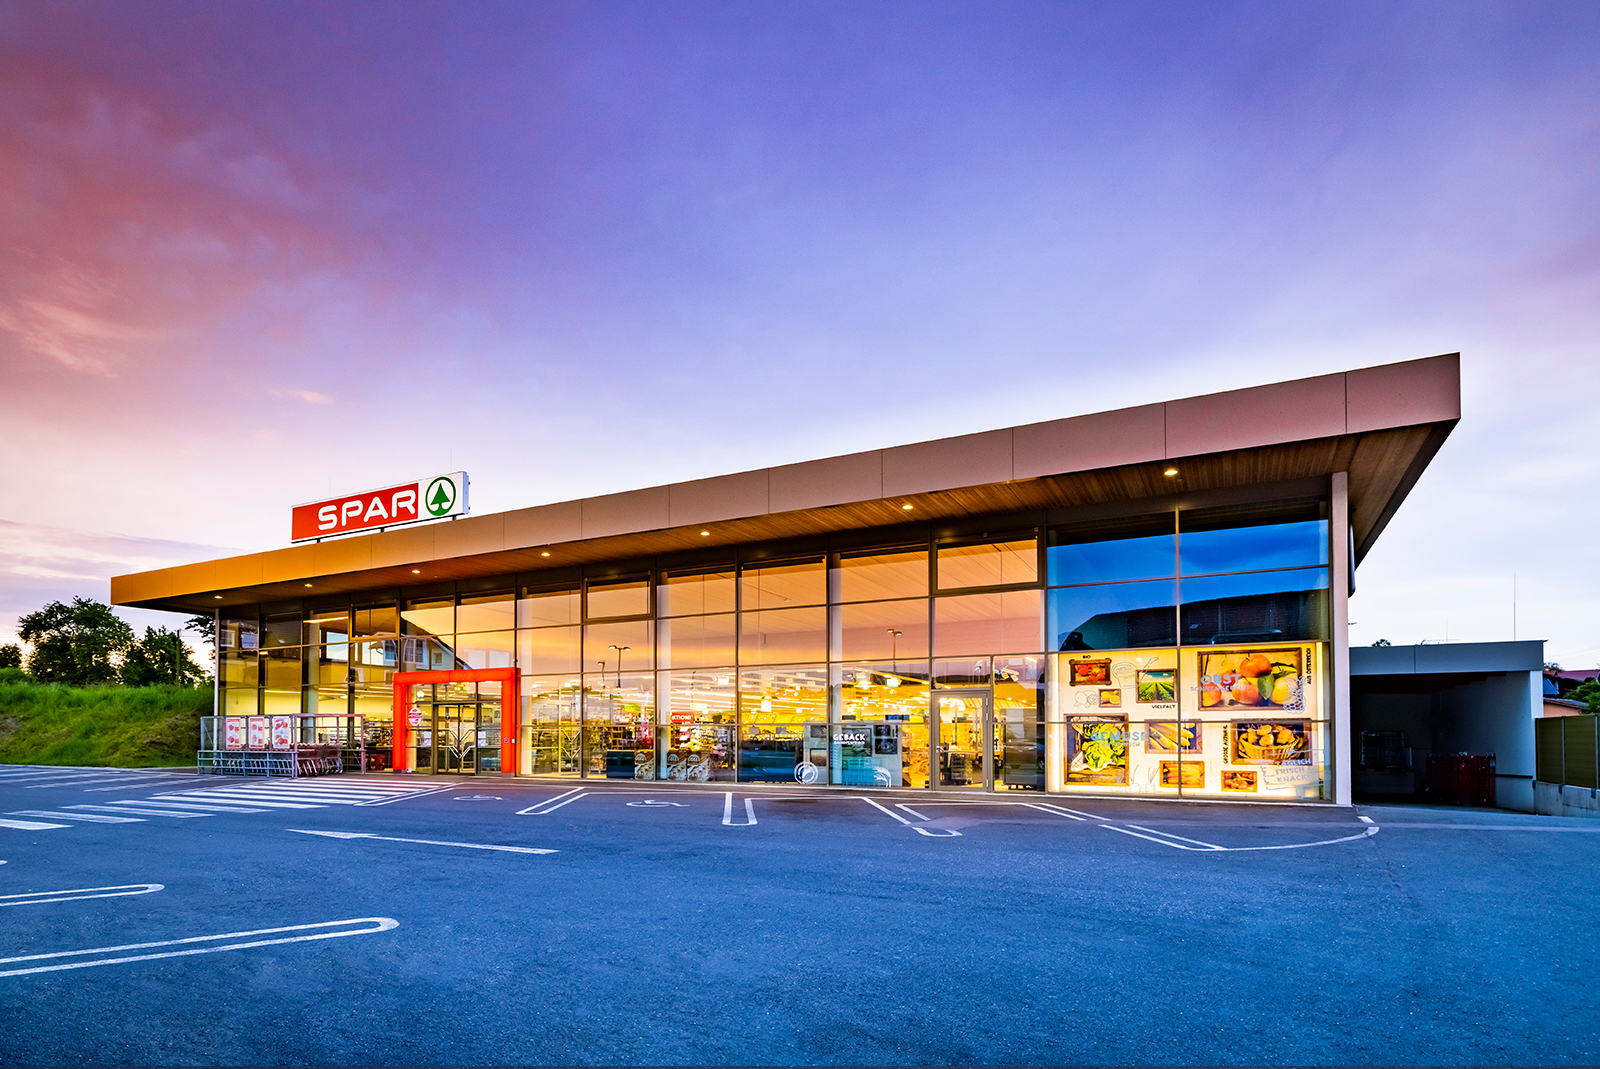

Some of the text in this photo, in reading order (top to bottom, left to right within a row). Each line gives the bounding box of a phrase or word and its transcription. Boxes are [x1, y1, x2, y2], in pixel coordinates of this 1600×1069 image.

[318, 489, 416, 531] SPAR
[1201, 673, 1242, 685] OBST
[1275, 766, 1305, 775] FRISCH
